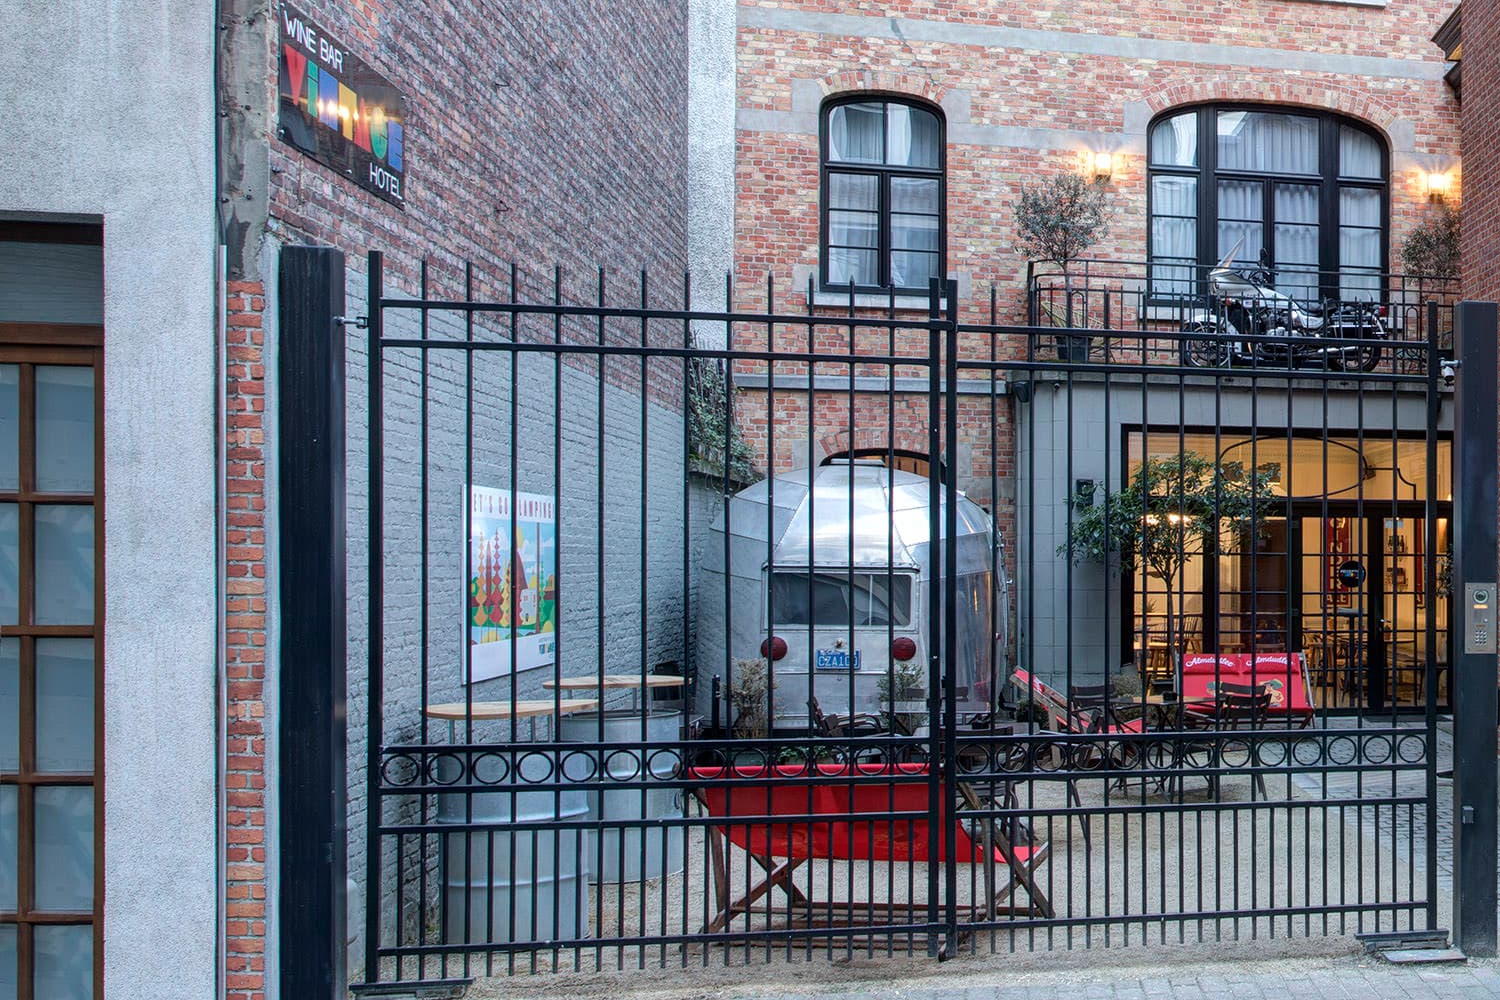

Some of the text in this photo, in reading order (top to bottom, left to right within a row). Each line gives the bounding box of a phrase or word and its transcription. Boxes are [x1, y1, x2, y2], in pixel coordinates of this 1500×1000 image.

[284, 10, 344, 74] WINE BAR
[369, 161, 403, 200] HOTEL
